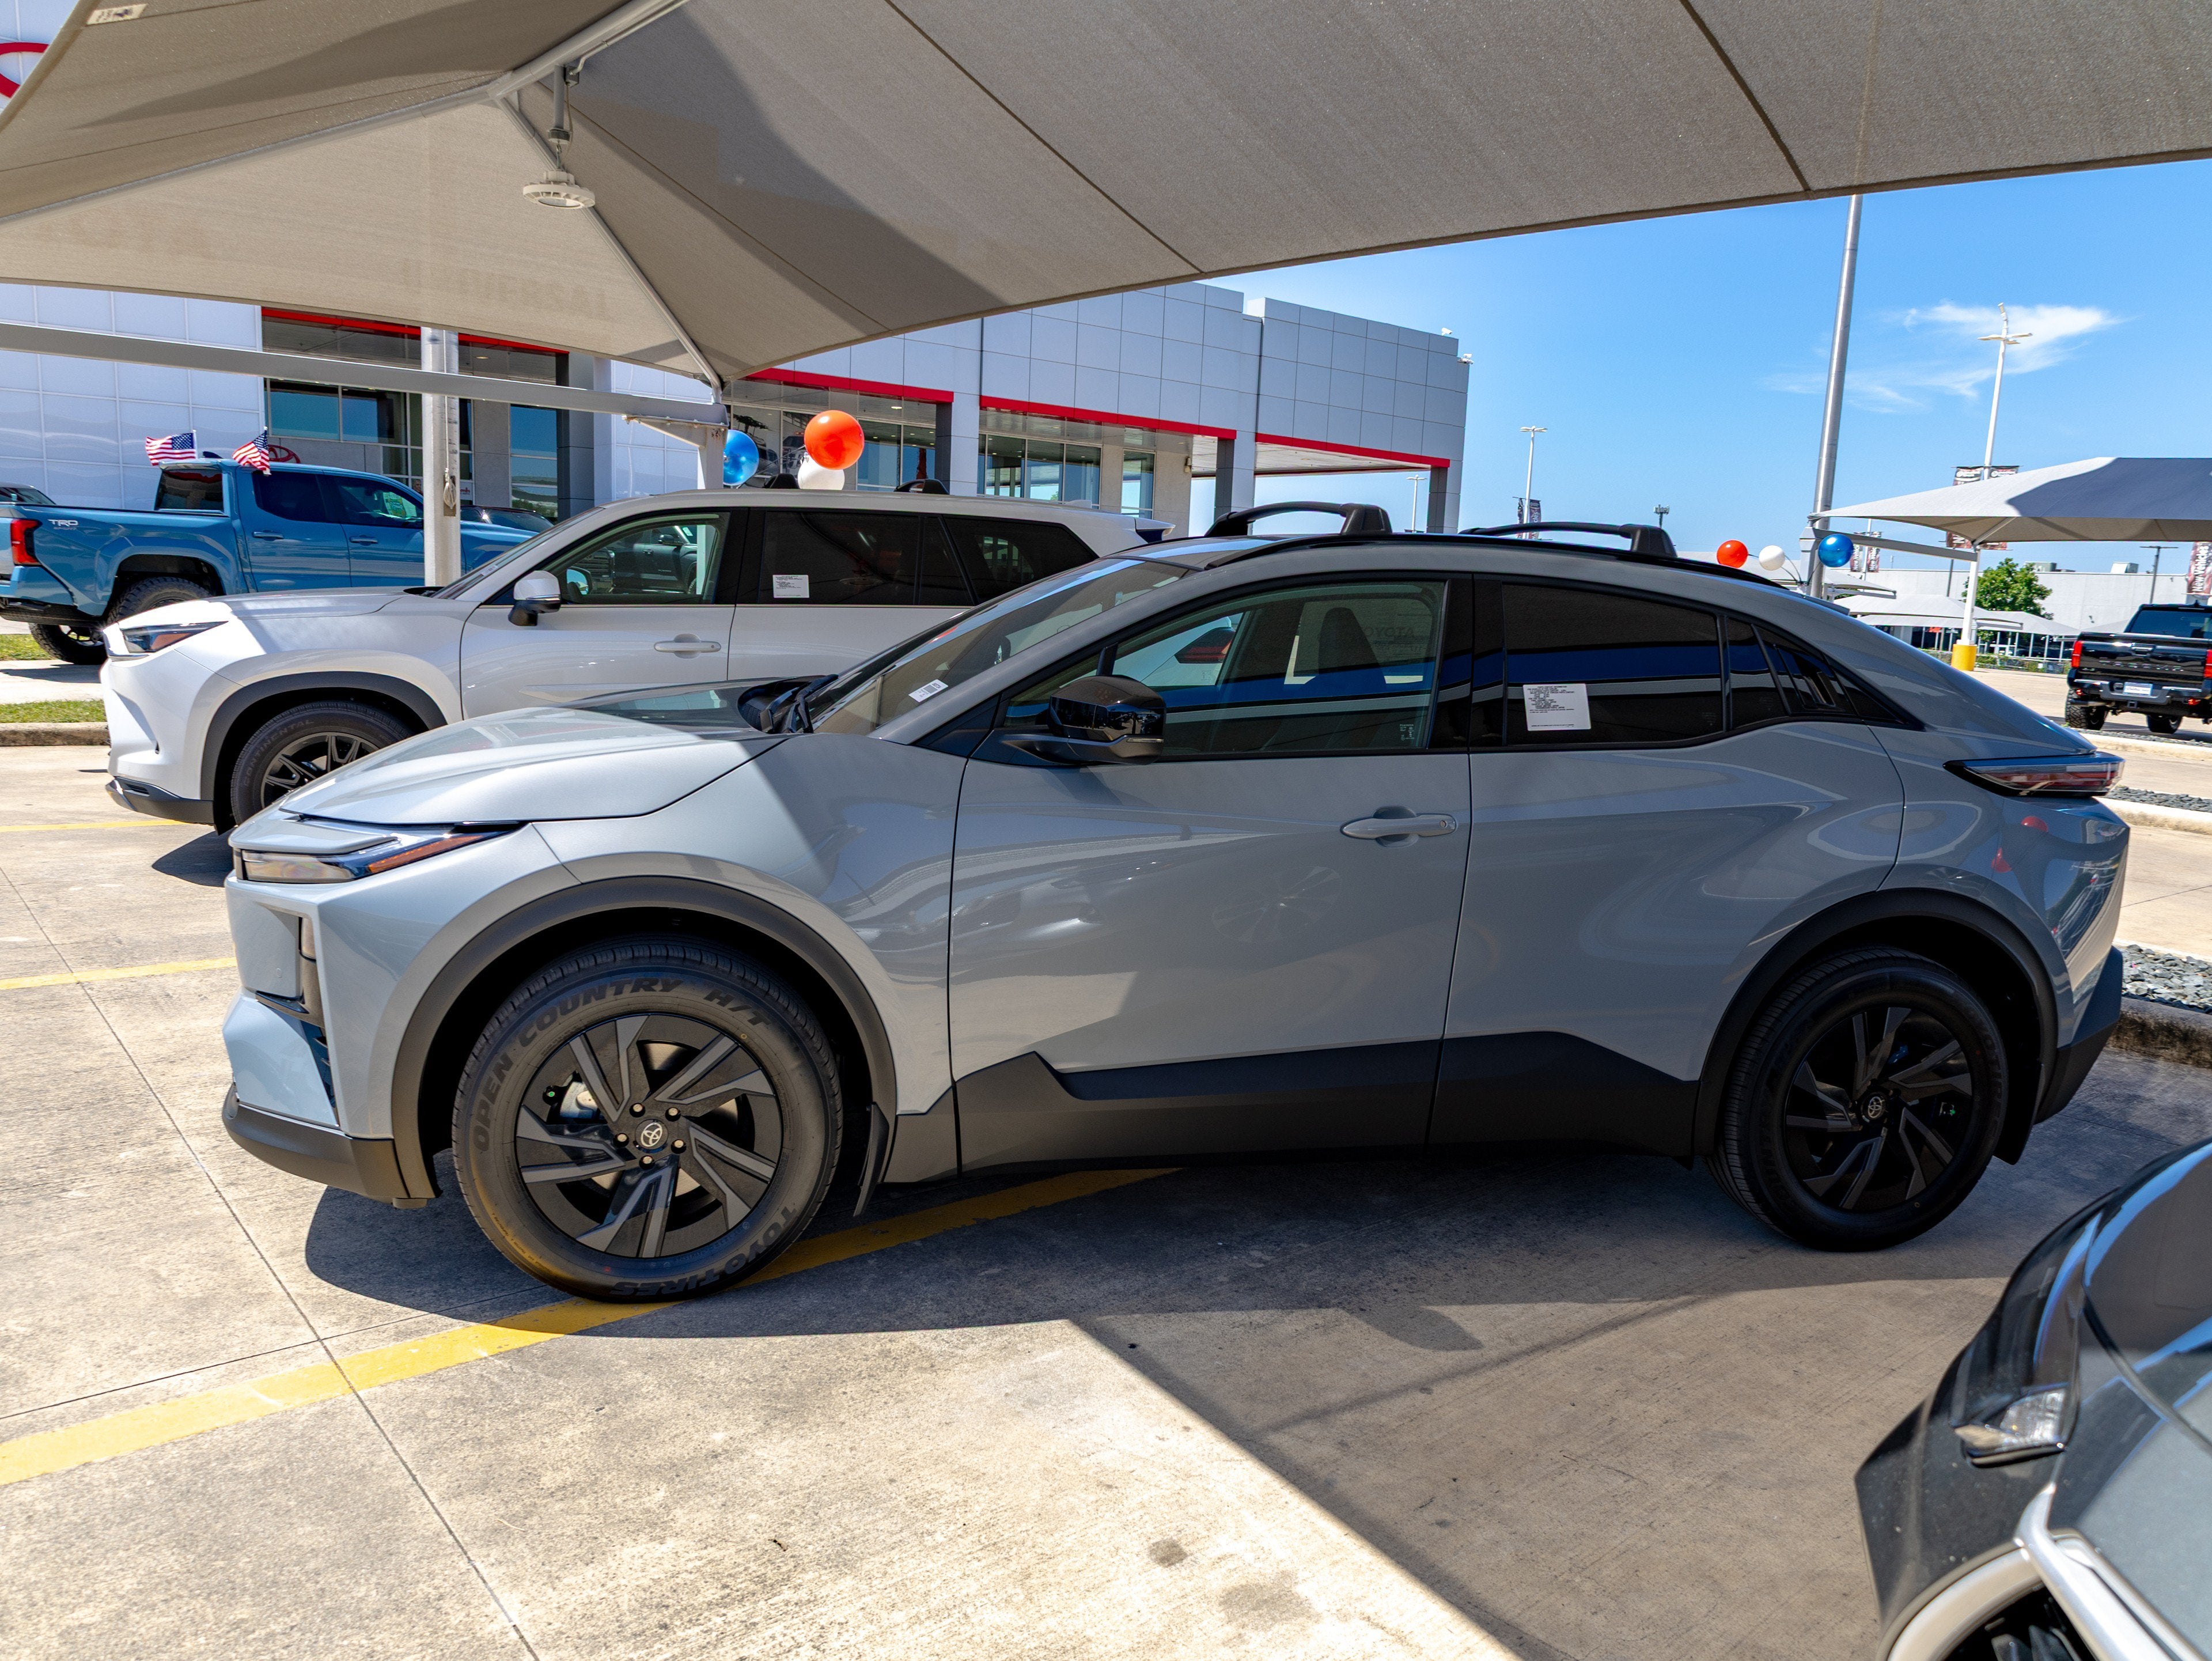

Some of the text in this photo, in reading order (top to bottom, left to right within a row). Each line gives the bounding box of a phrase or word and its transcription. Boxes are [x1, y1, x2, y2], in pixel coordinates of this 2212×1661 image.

[47, 519, 79, 527] TRD
[2192, 545, 2210, 592] New Vehicles
[473, 1053, 517, 1152] OPEN
[518, 977, 683, 1048] COUNTRY
[703, 989, 774, 1027] H/T
[724, 1206, 798, 1274] TOYO
[609, 1268, 720, 1296] TIRES
